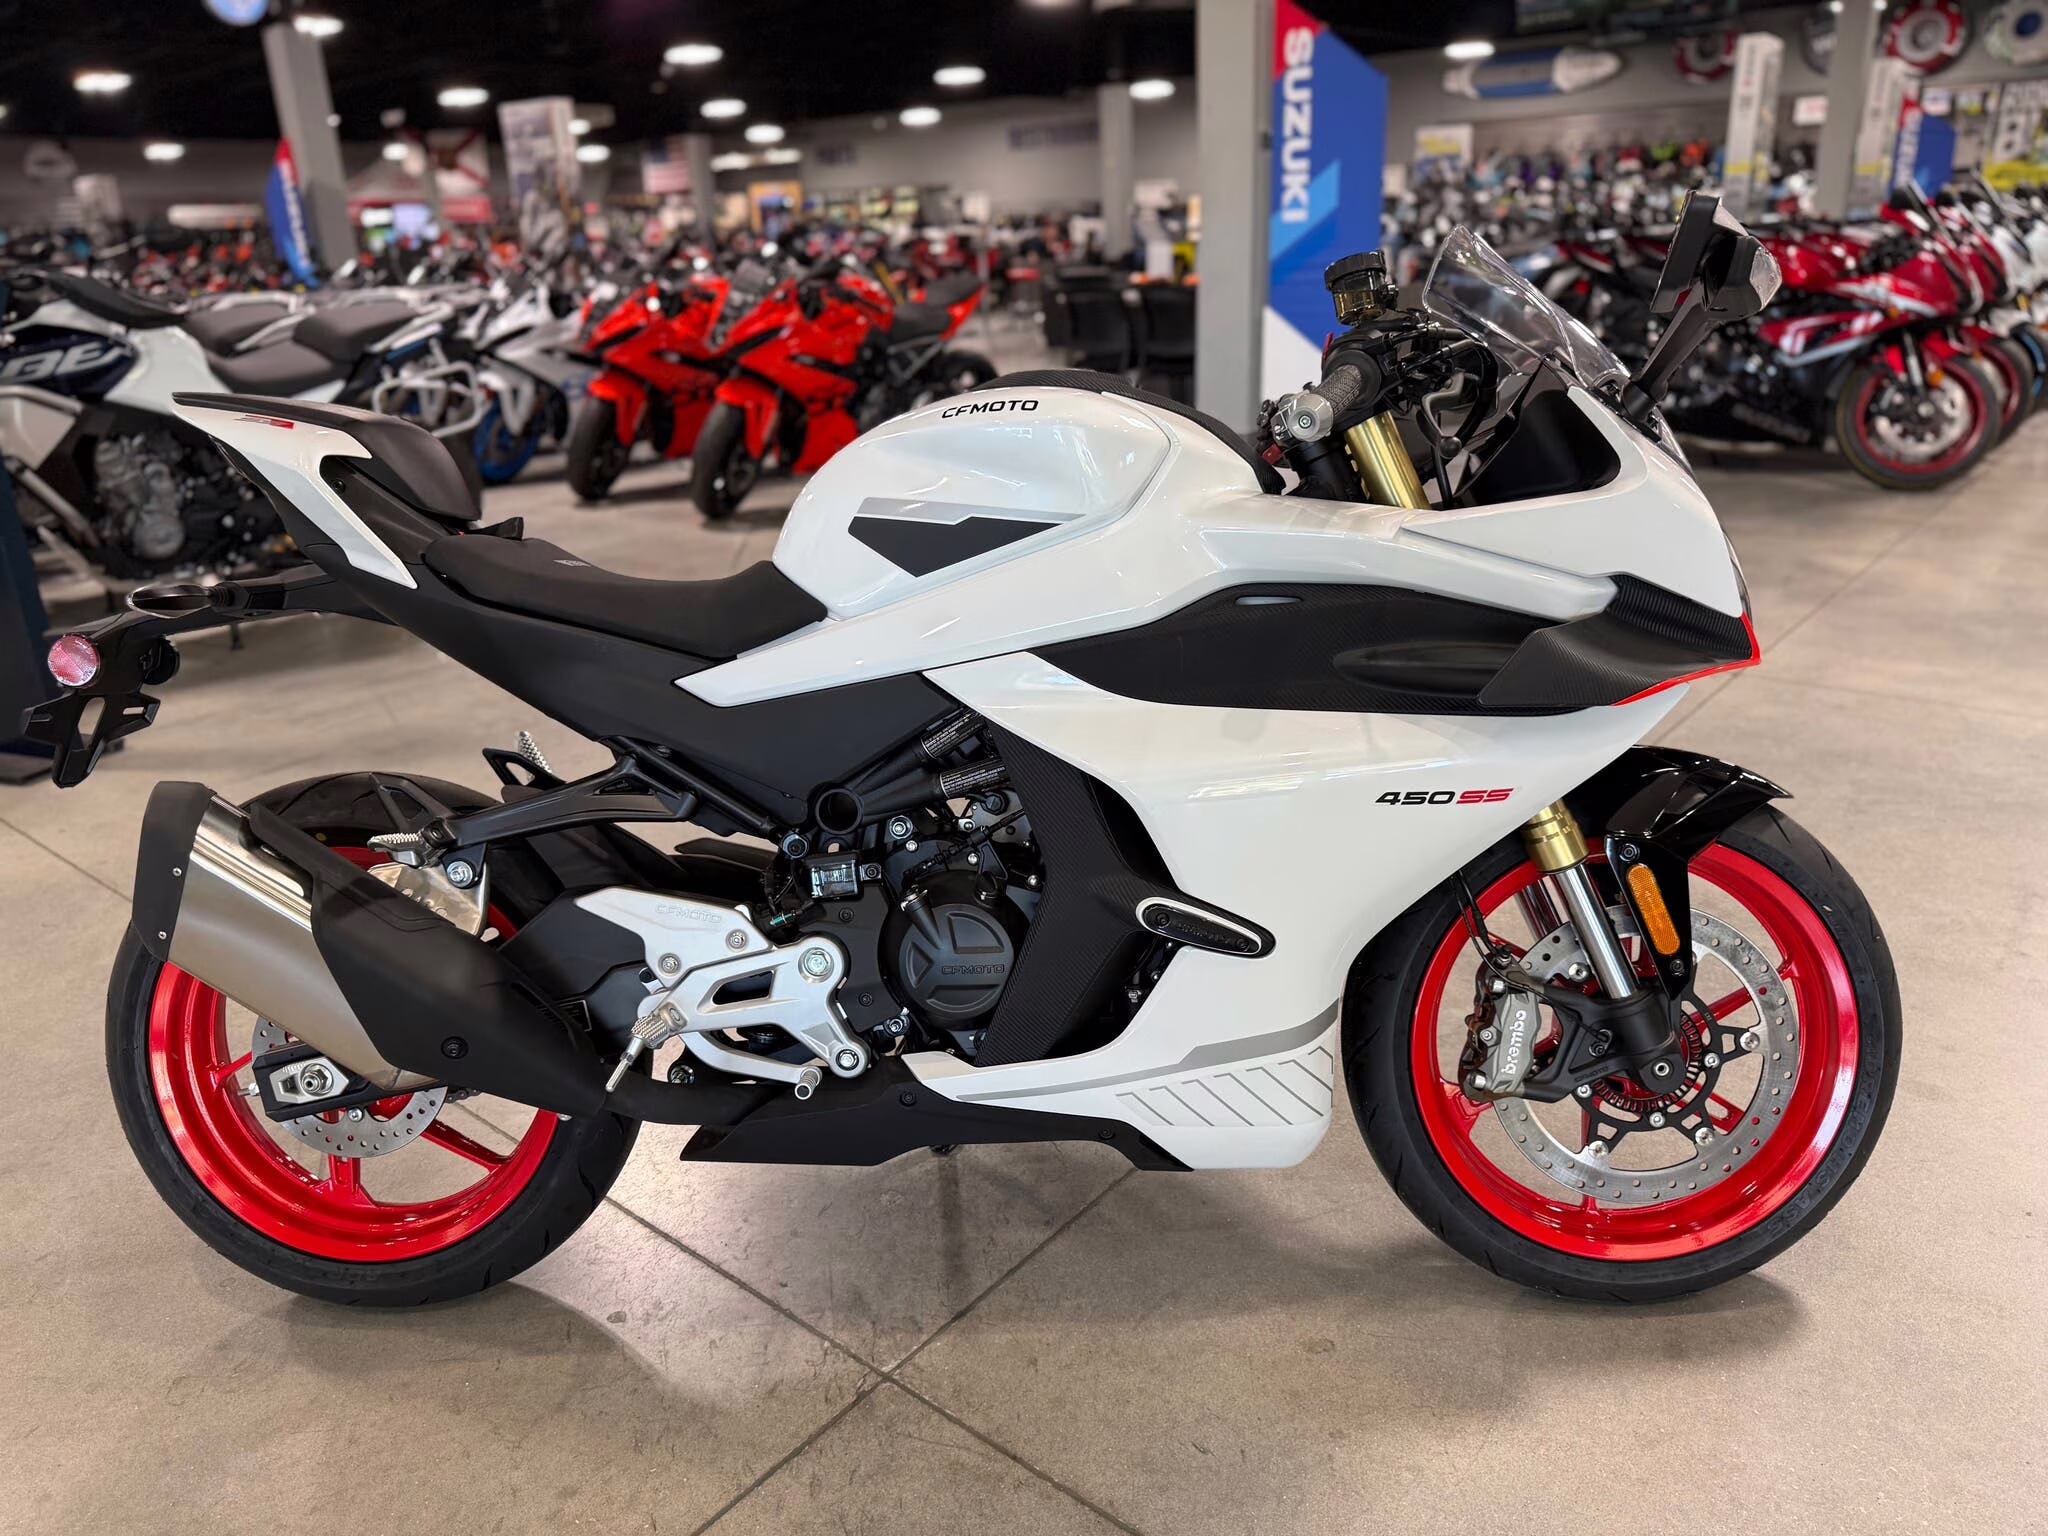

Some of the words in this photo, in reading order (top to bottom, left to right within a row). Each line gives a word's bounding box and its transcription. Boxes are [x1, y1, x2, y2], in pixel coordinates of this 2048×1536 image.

[1281, 26, 1314, 223] SUZUKI
[941, 400, 1039, 418] CFMOTO
[1375, 788, 1514, 805] 450SS
[655, 904, 722, 923] CFMOTO
[941, 963, 1005, 975] CFMOTO
[1500, 1010, 1527, 1075] brembo
